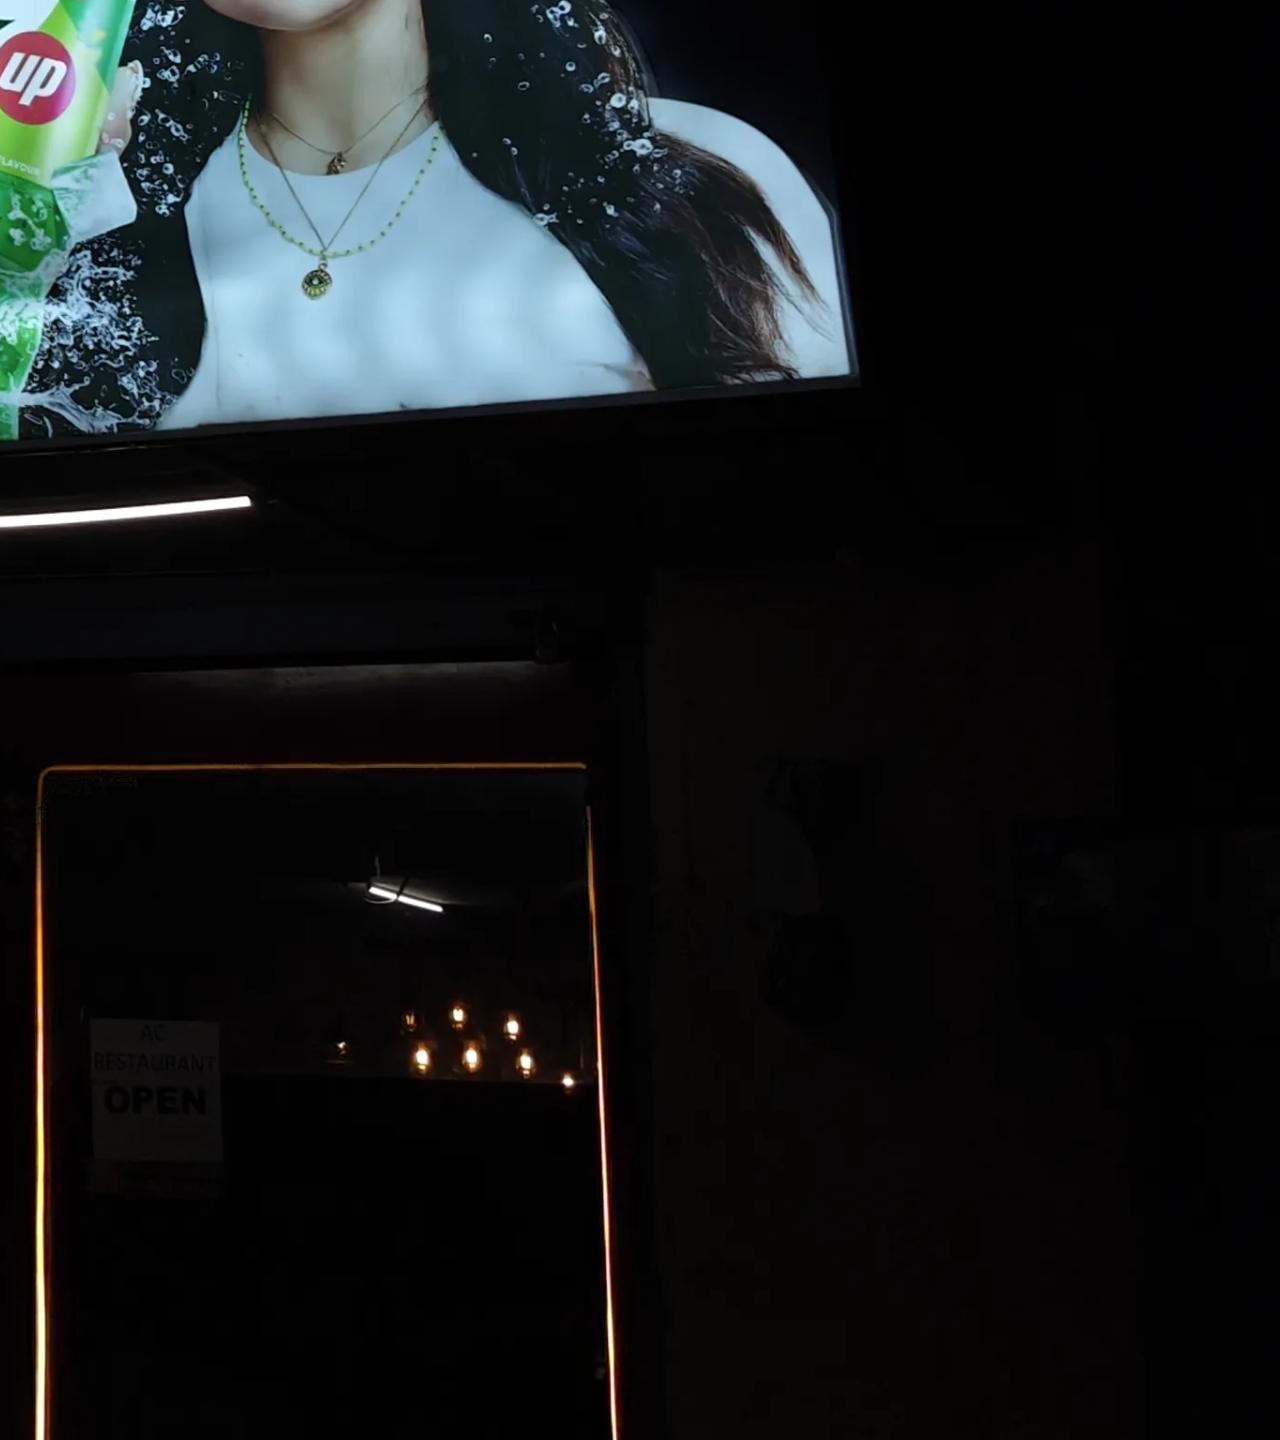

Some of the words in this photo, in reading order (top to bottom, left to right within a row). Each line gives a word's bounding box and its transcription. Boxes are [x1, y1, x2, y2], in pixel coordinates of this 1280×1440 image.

[141, 1024, 167, 1042] AC
[94, 1051, 216, 1073] RESTAURANT
[105, 1086, 207, 1115] OPEN
